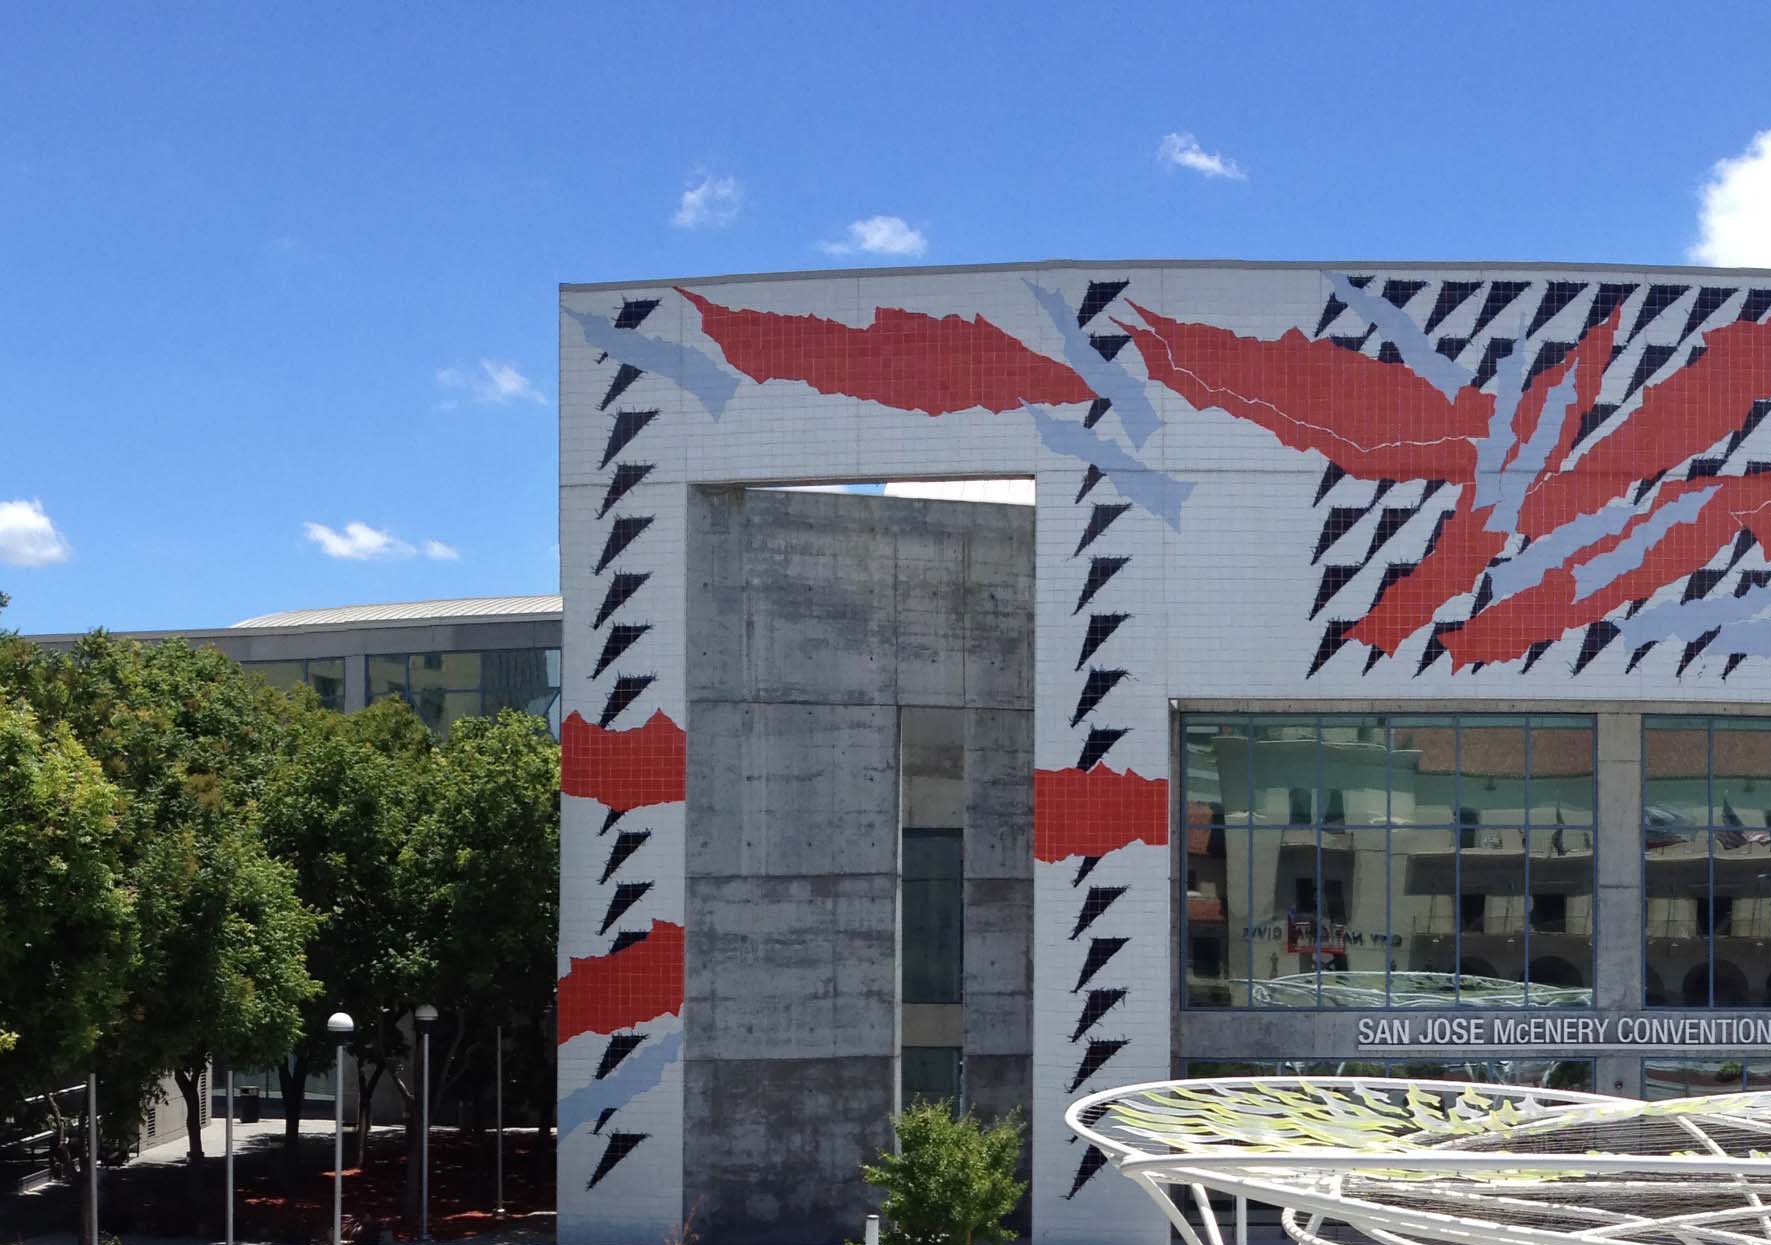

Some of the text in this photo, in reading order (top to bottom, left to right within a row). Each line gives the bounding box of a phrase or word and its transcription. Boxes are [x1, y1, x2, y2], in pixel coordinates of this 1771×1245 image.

[1358, 1018, 1410, 1044] SAN
[1418, 1018, 1485, 1044] JOSE
[1493, 1018, 1609, 1044] McENERY
